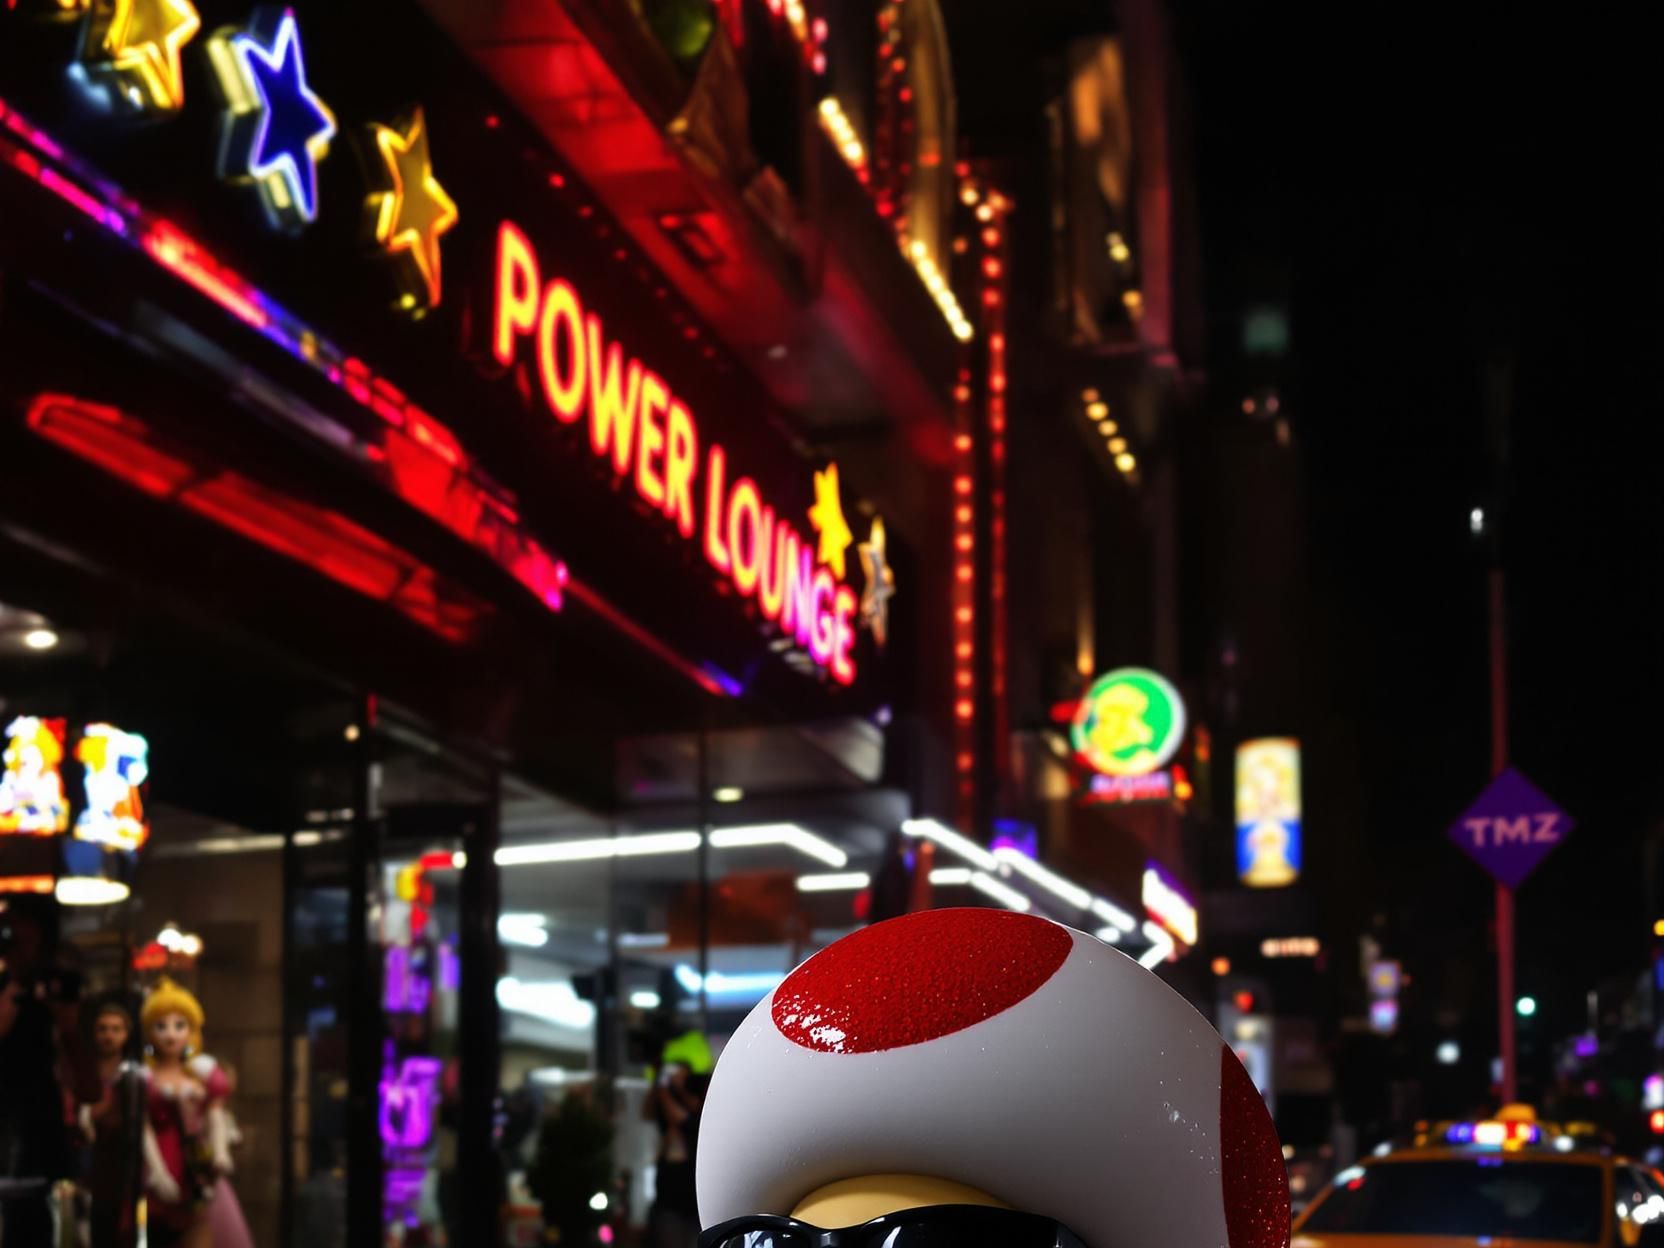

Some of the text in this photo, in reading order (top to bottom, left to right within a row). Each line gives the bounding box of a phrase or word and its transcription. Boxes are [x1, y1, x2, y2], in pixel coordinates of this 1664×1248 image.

[495, 220, 855, 686] POWER LOUNGE
[1464, 813, 1558, 846] TMZ
